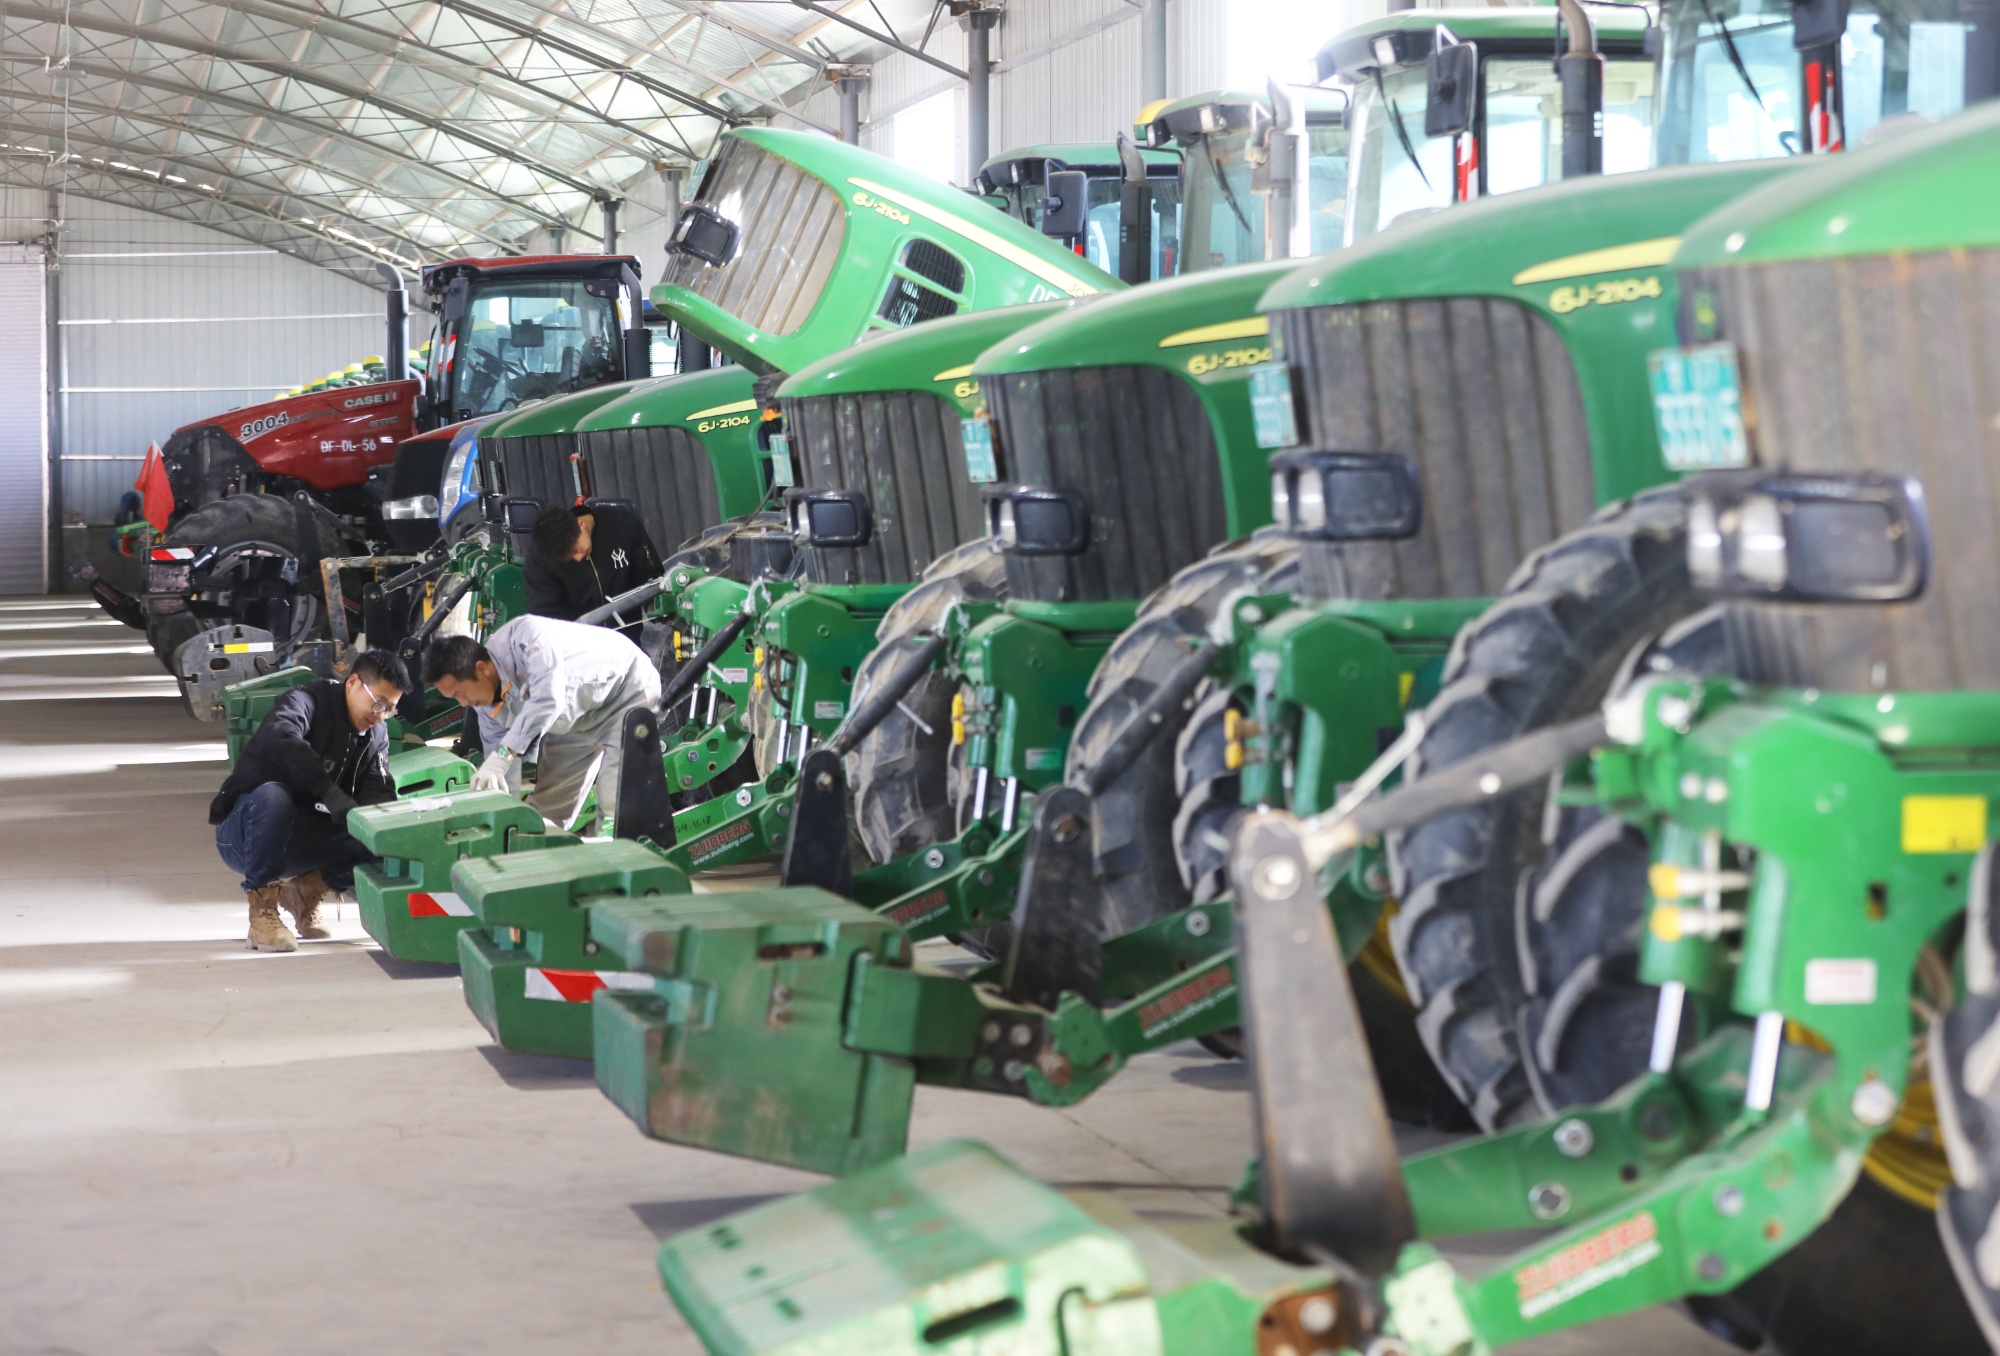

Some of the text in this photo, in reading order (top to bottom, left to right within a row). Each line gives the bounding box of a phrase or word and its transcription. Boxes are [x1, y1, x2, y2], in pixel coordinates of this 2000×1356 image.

[852, 192, 910, 226] 6J-2104
[1549, 276, 1663, 313] 6J-2104
[344, 394, 383, 408] CASE
[241, 411, 289, 438] 3004
[697, 415, 751, 433] 6J-2104
[688, 819, 752, 859] ZUIDBERG
[692, 832, 755, 866] www.zuidberg.com
